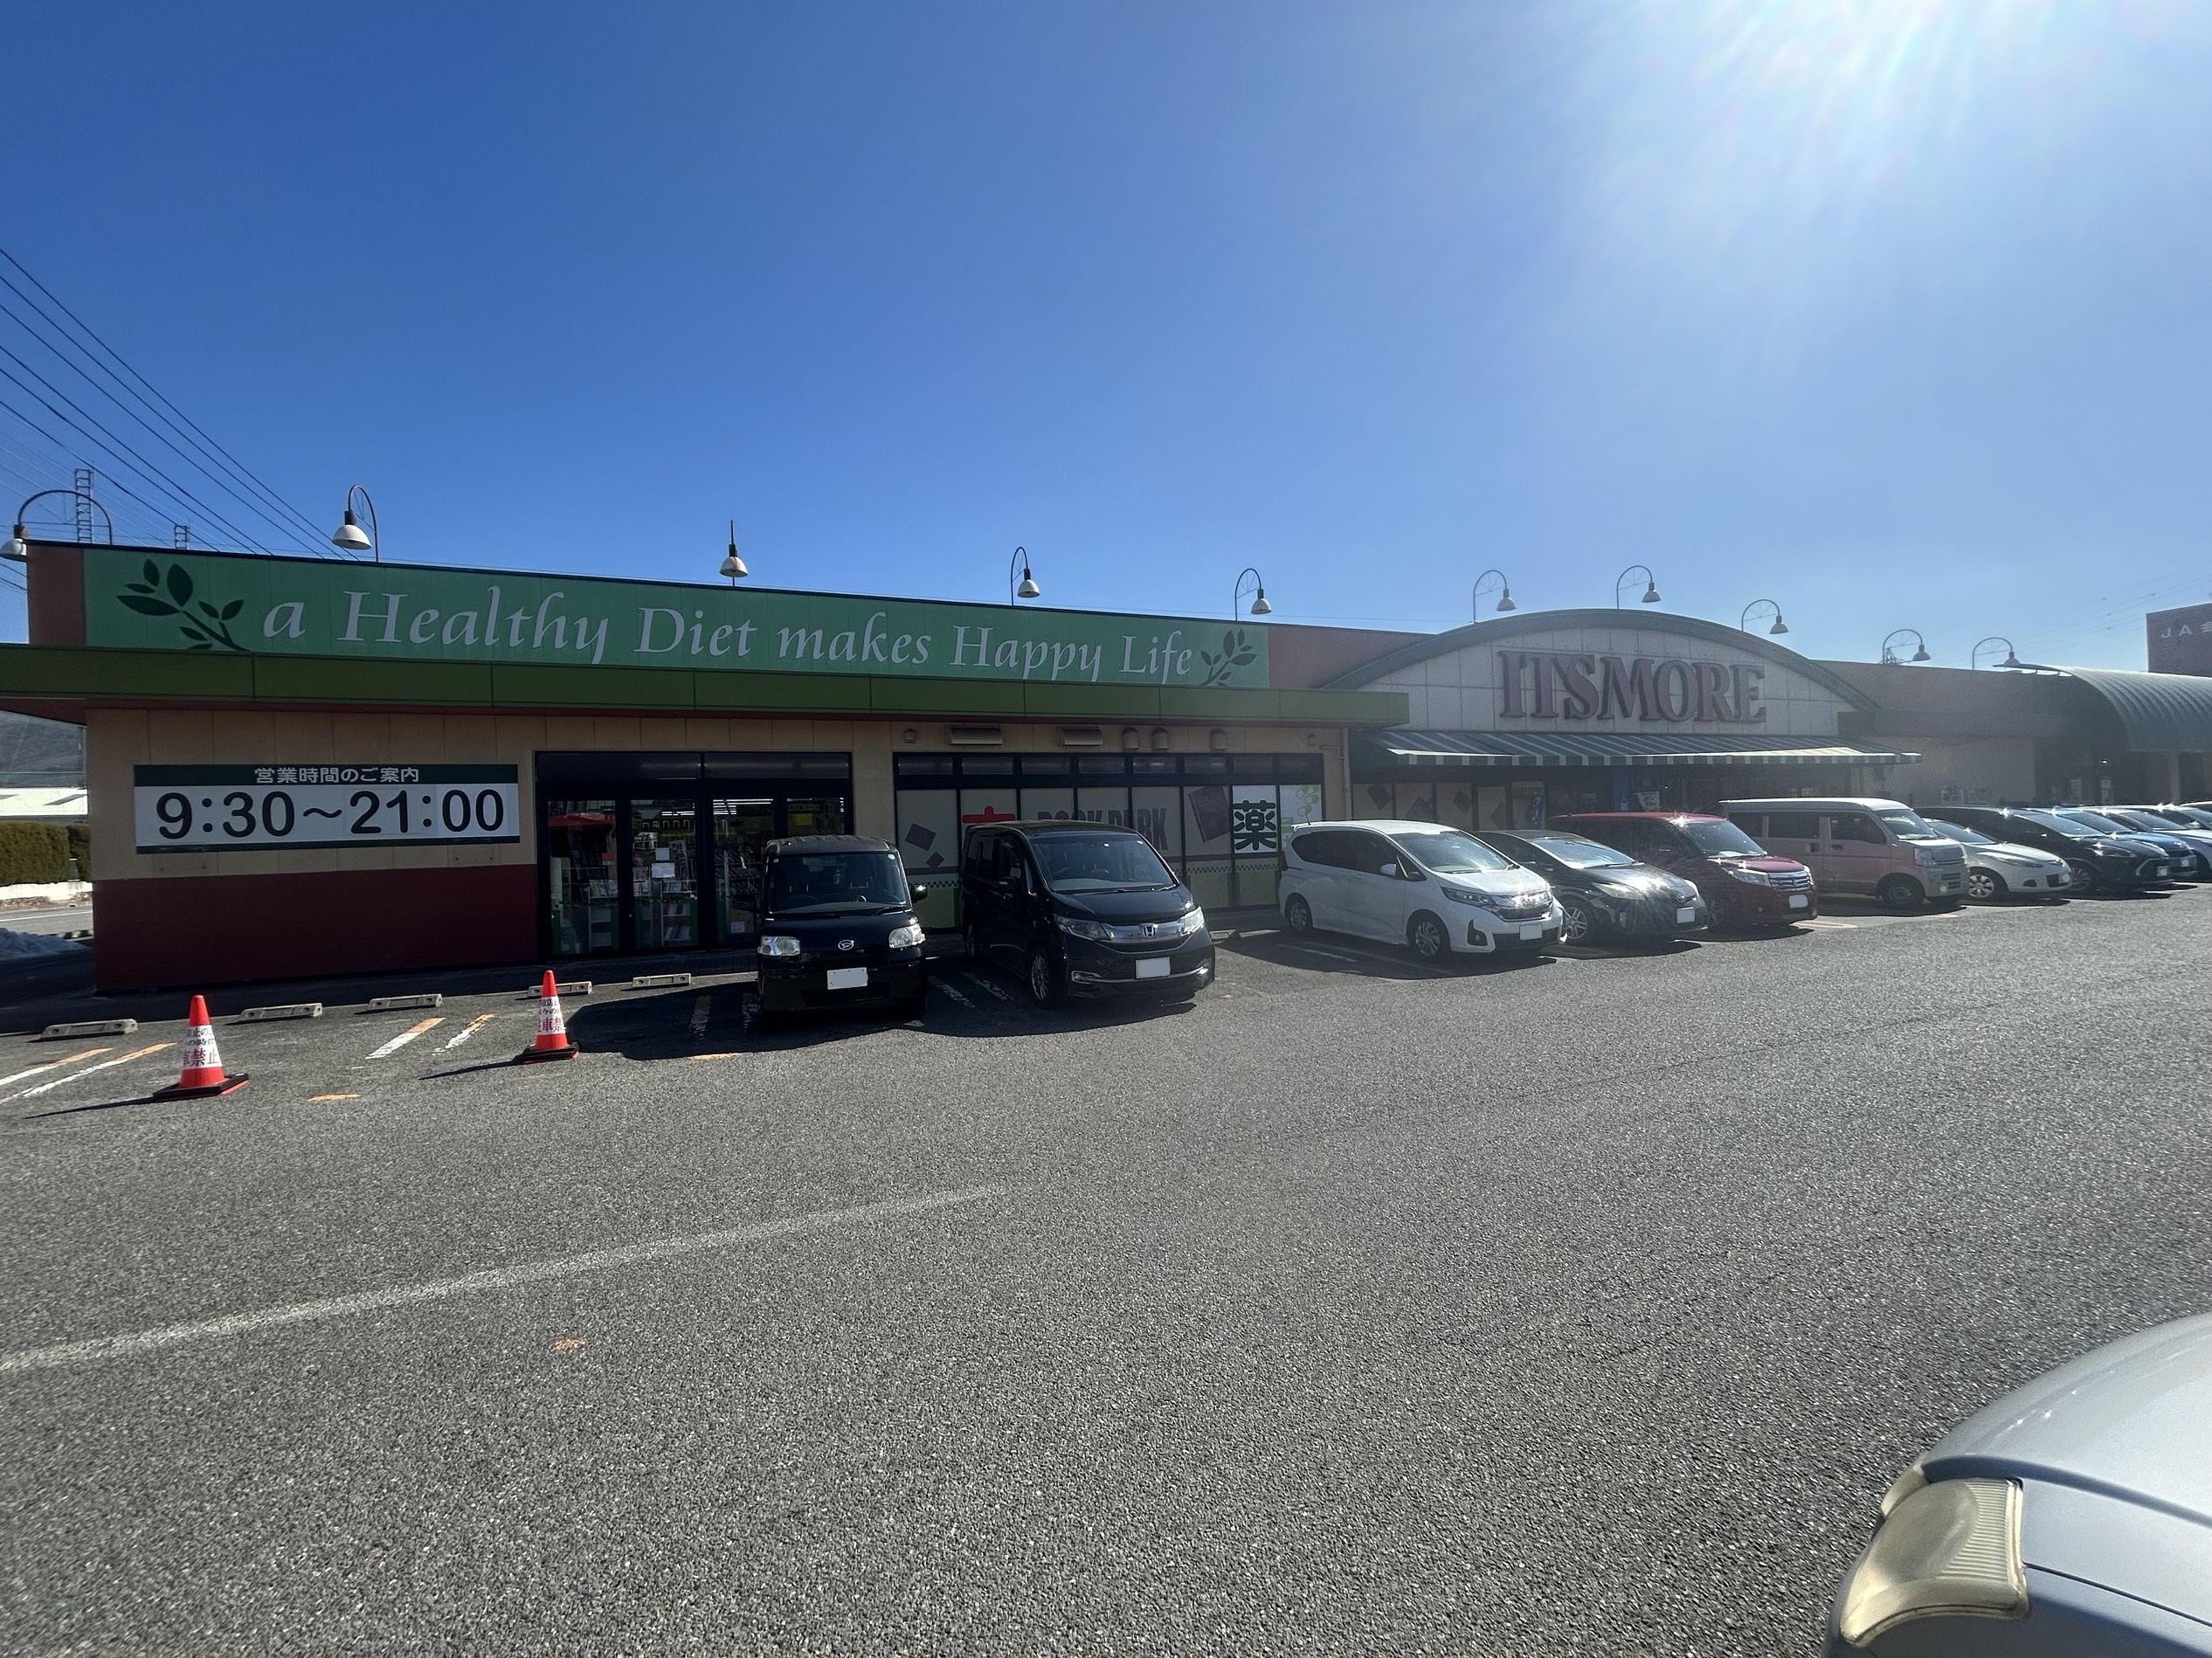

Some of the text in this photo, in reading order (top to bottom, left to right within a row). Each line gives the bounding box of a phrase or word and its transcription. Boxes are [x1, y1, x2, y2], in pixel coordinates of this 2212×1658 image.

[263, 585, 1193, 684] a Healthy Diet makes Happy Life
[254, 766, 419, 784] 営業時間のご案内
[1233, 799, 1277, 851] 薬
